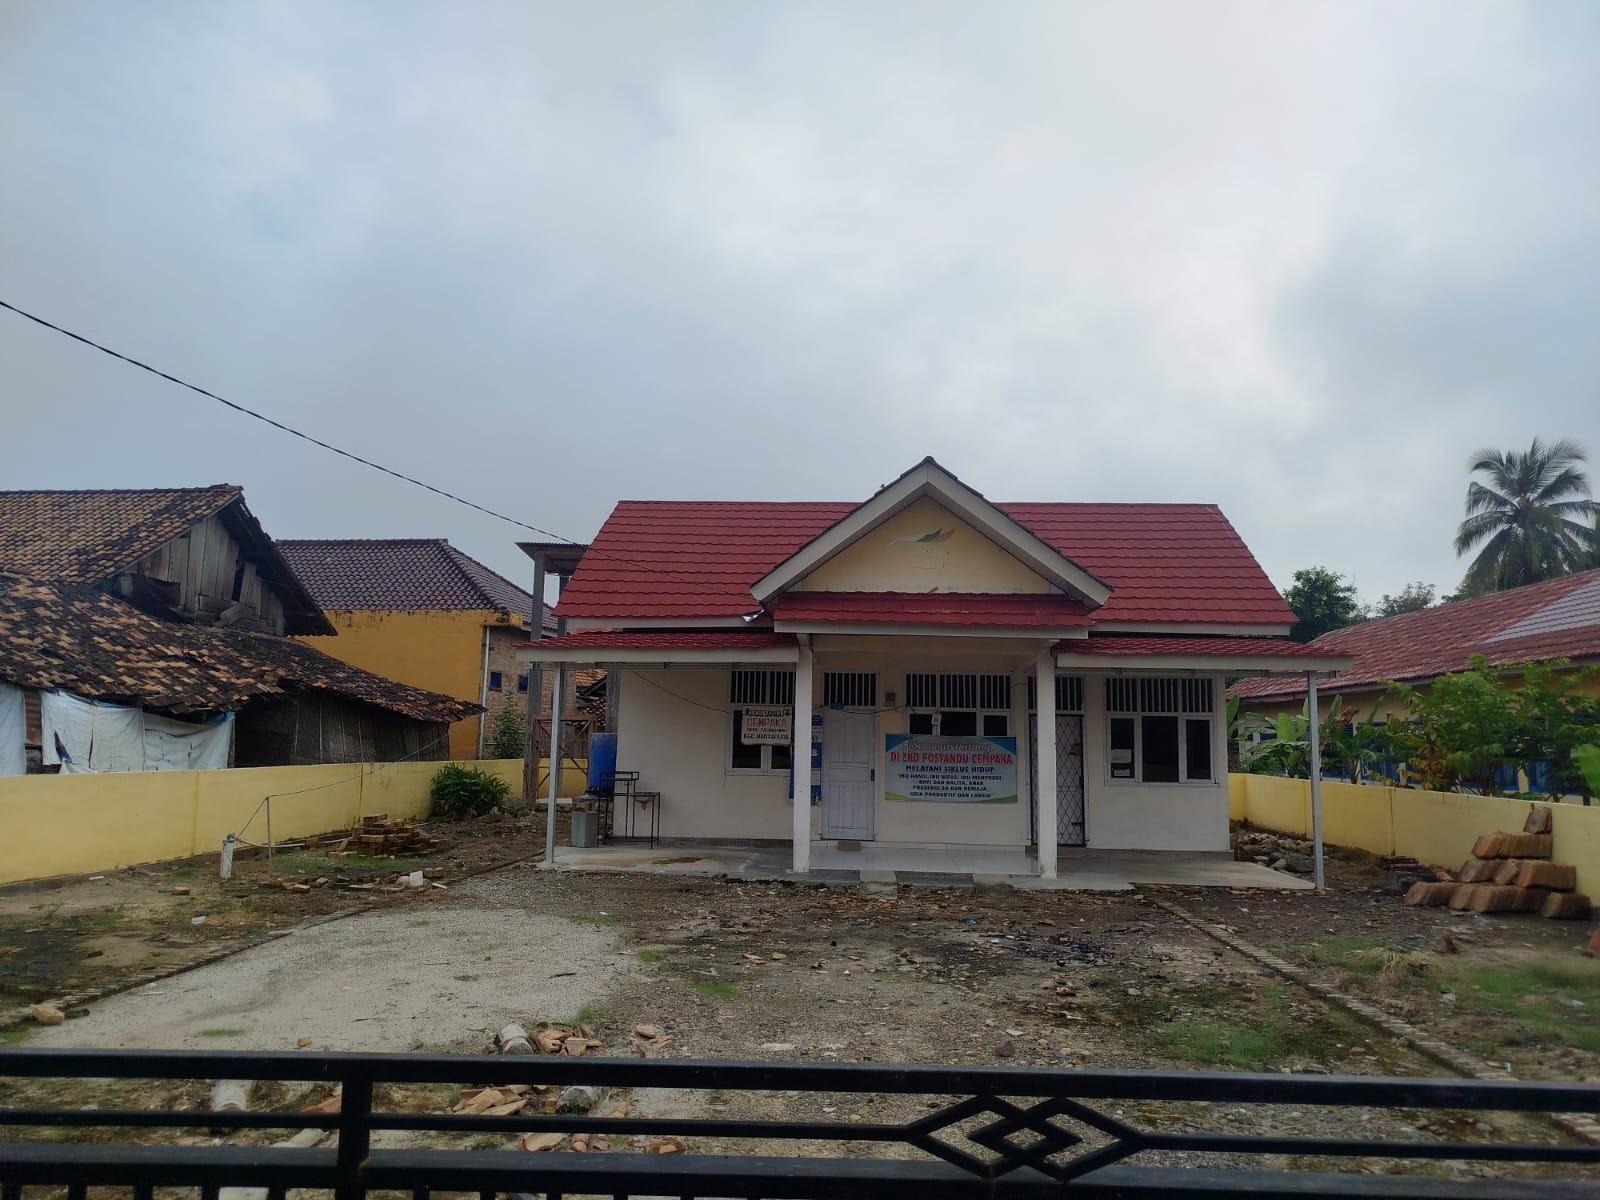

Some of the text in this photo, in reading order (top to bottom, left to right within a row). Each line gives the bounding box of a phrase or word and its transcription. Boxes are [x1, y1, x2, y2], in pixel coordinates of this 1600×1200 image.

[890, 752, 900, 762] DI
[922, 753, 968, 764] POSYANDU
[972, 754, 1012, 764] CEMPAKA
